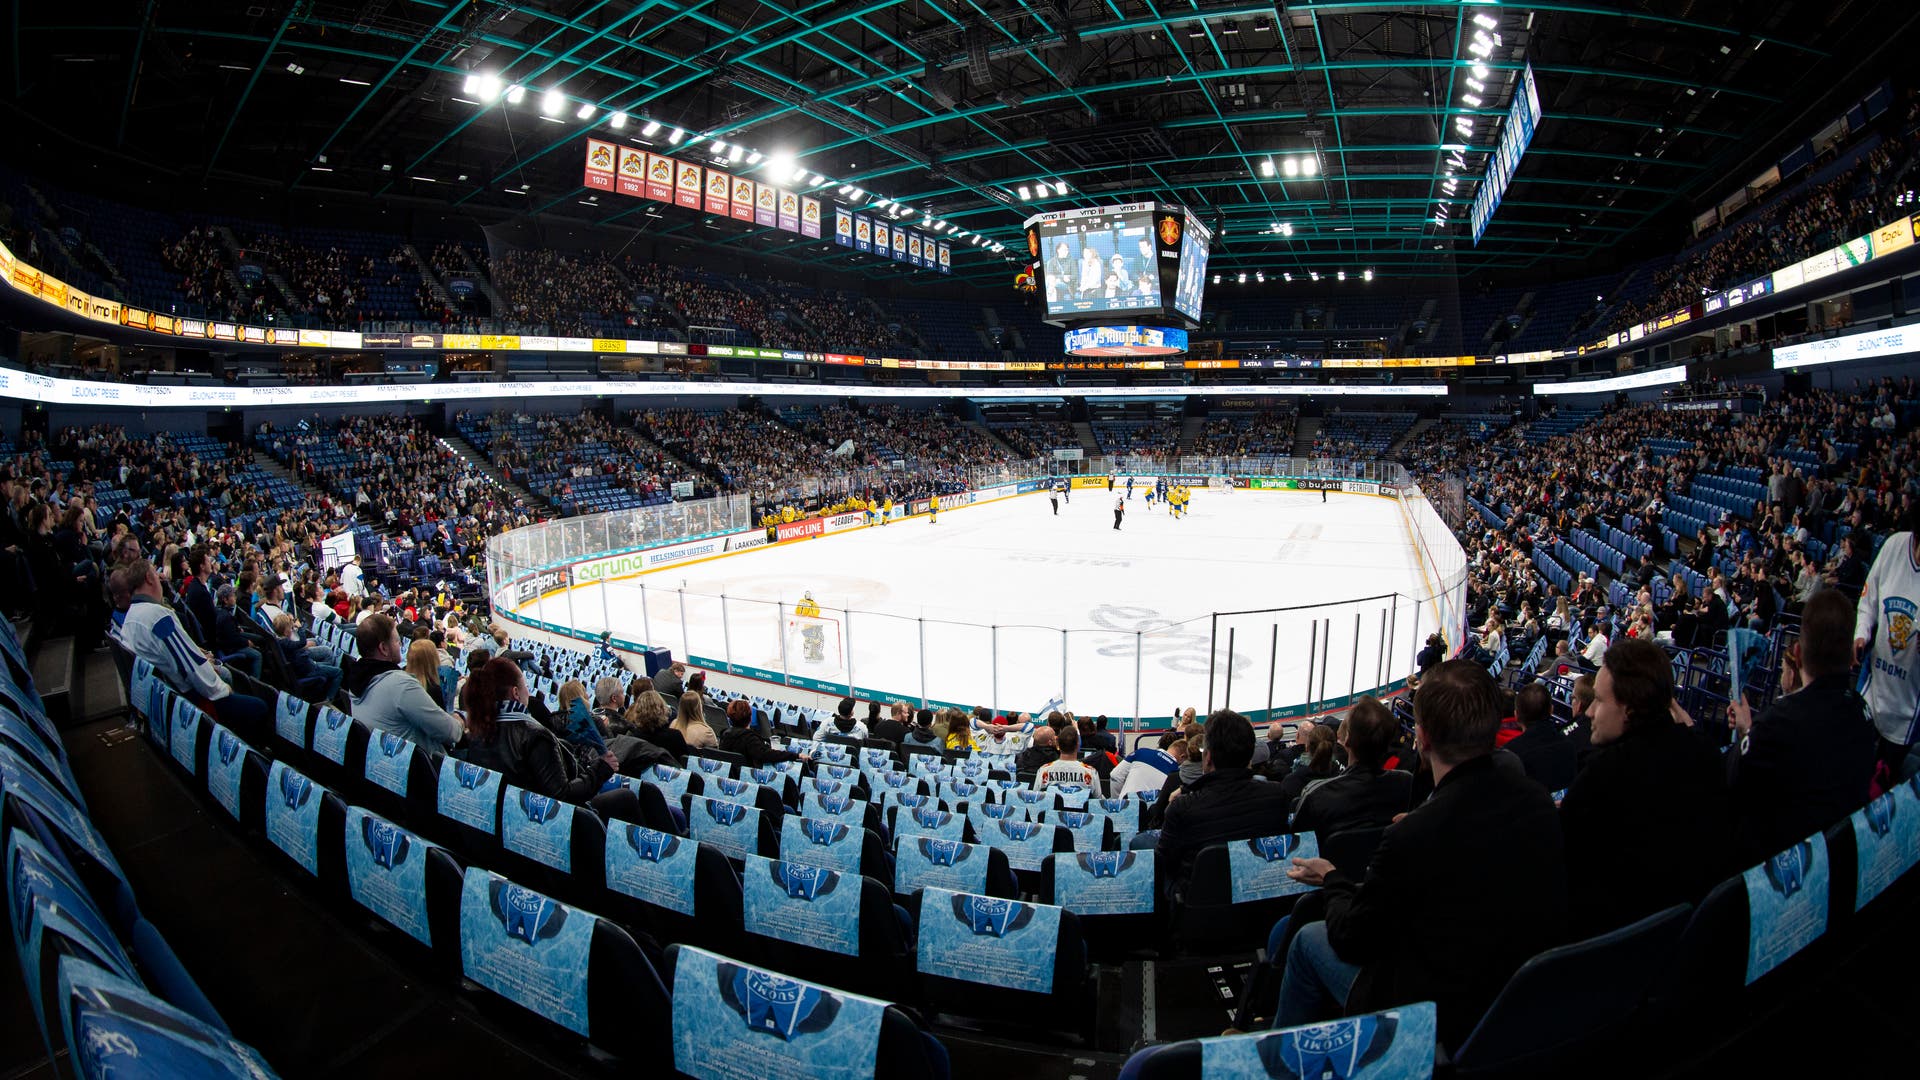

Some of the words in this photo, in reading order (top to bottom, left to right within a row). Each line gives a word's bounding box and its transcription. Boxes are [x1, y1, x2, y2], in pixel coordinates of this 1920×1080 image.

[592, 176, 608, 185] 1973
[623, 182, 639, 192] 1992
[735, 208, 749, 217] 2002
[1080, 208, 1097, 216] vmp
[1120, 204, 1137, 212] vmp
[1041, 212, 1058, 221] vmp
[1881, 226, 1904, 244] topi
[69, 294, 83, 309] vmp
[92, 304, 110, 319] vmp
[1198, 360, 1222, 368] renta
[1082, 477, 1102, 485] Hertz
[1261, 480, 1288, 490] planex
[834, 515, 854, 526] LEADER
[778, 525, 805, 540] VIKING
[805, 522, 822, 534] LINE
[650, 549, 687, 564] HELSINGIN
[686, 544, 714, 558] UUTISET
[579, 555, 643, 581] caruna
[700, 660, 716, 668] intrum
[1875, 657, 1907, 681] SUOMI
[755, 671, 773, 679] intrum
[817, 683, 837, 692] intrum
[885, 695, 907, 704] intrum
[1272, 708, 1294, 718] intrum
[1049, 771, 1084, 783] KARJALA
[511, 894, 538, 912] SUOMI
[974, 902, 1007, 914] SUOMI
[752, 981, 799, 1001] SUOMI
[1303, 1031, 1352, 1050] SUOMI
